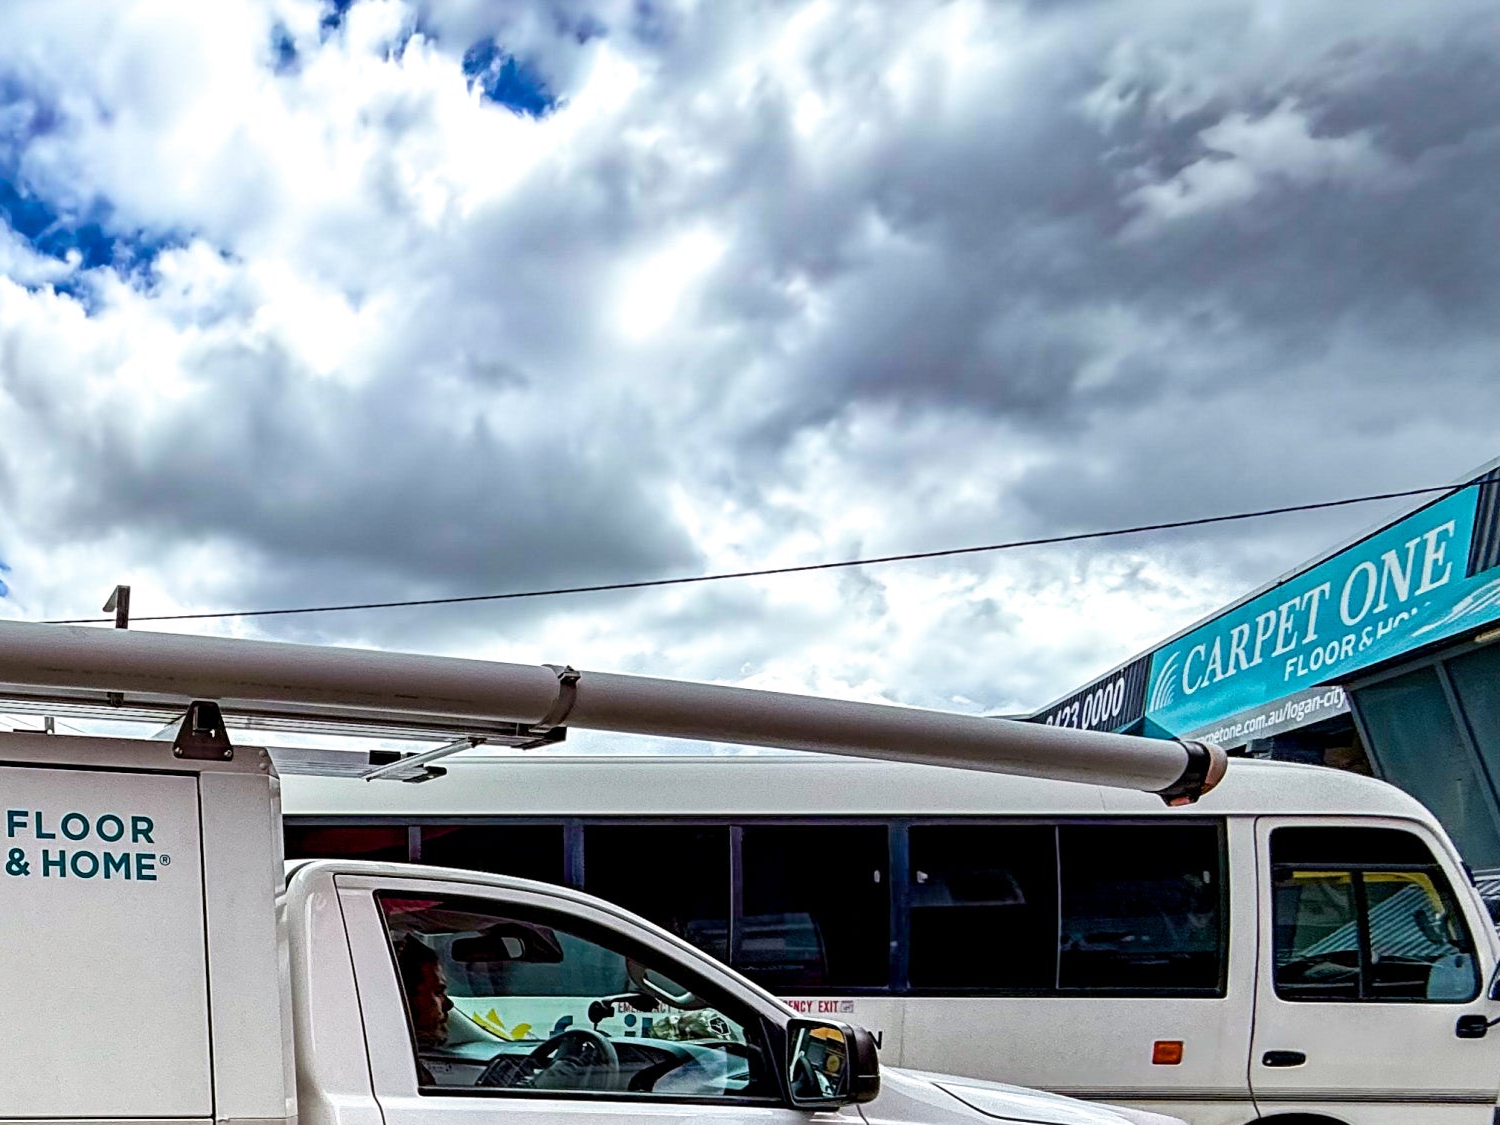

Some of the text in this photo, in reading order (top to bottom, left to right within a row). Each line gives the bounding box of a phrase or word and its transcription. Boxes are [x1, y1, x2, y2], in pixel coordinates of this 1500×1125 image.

[1182, 519, 1457, 695] CARPET ONE
[1284, 633, 1357, 681] FLOOR
[1081, 677, 1125, 730] 0000
[6, 809, 155, 844] FLOOR
[5, 847, 31, 877] &
[817, 1000, 839, 1013] EXIT
